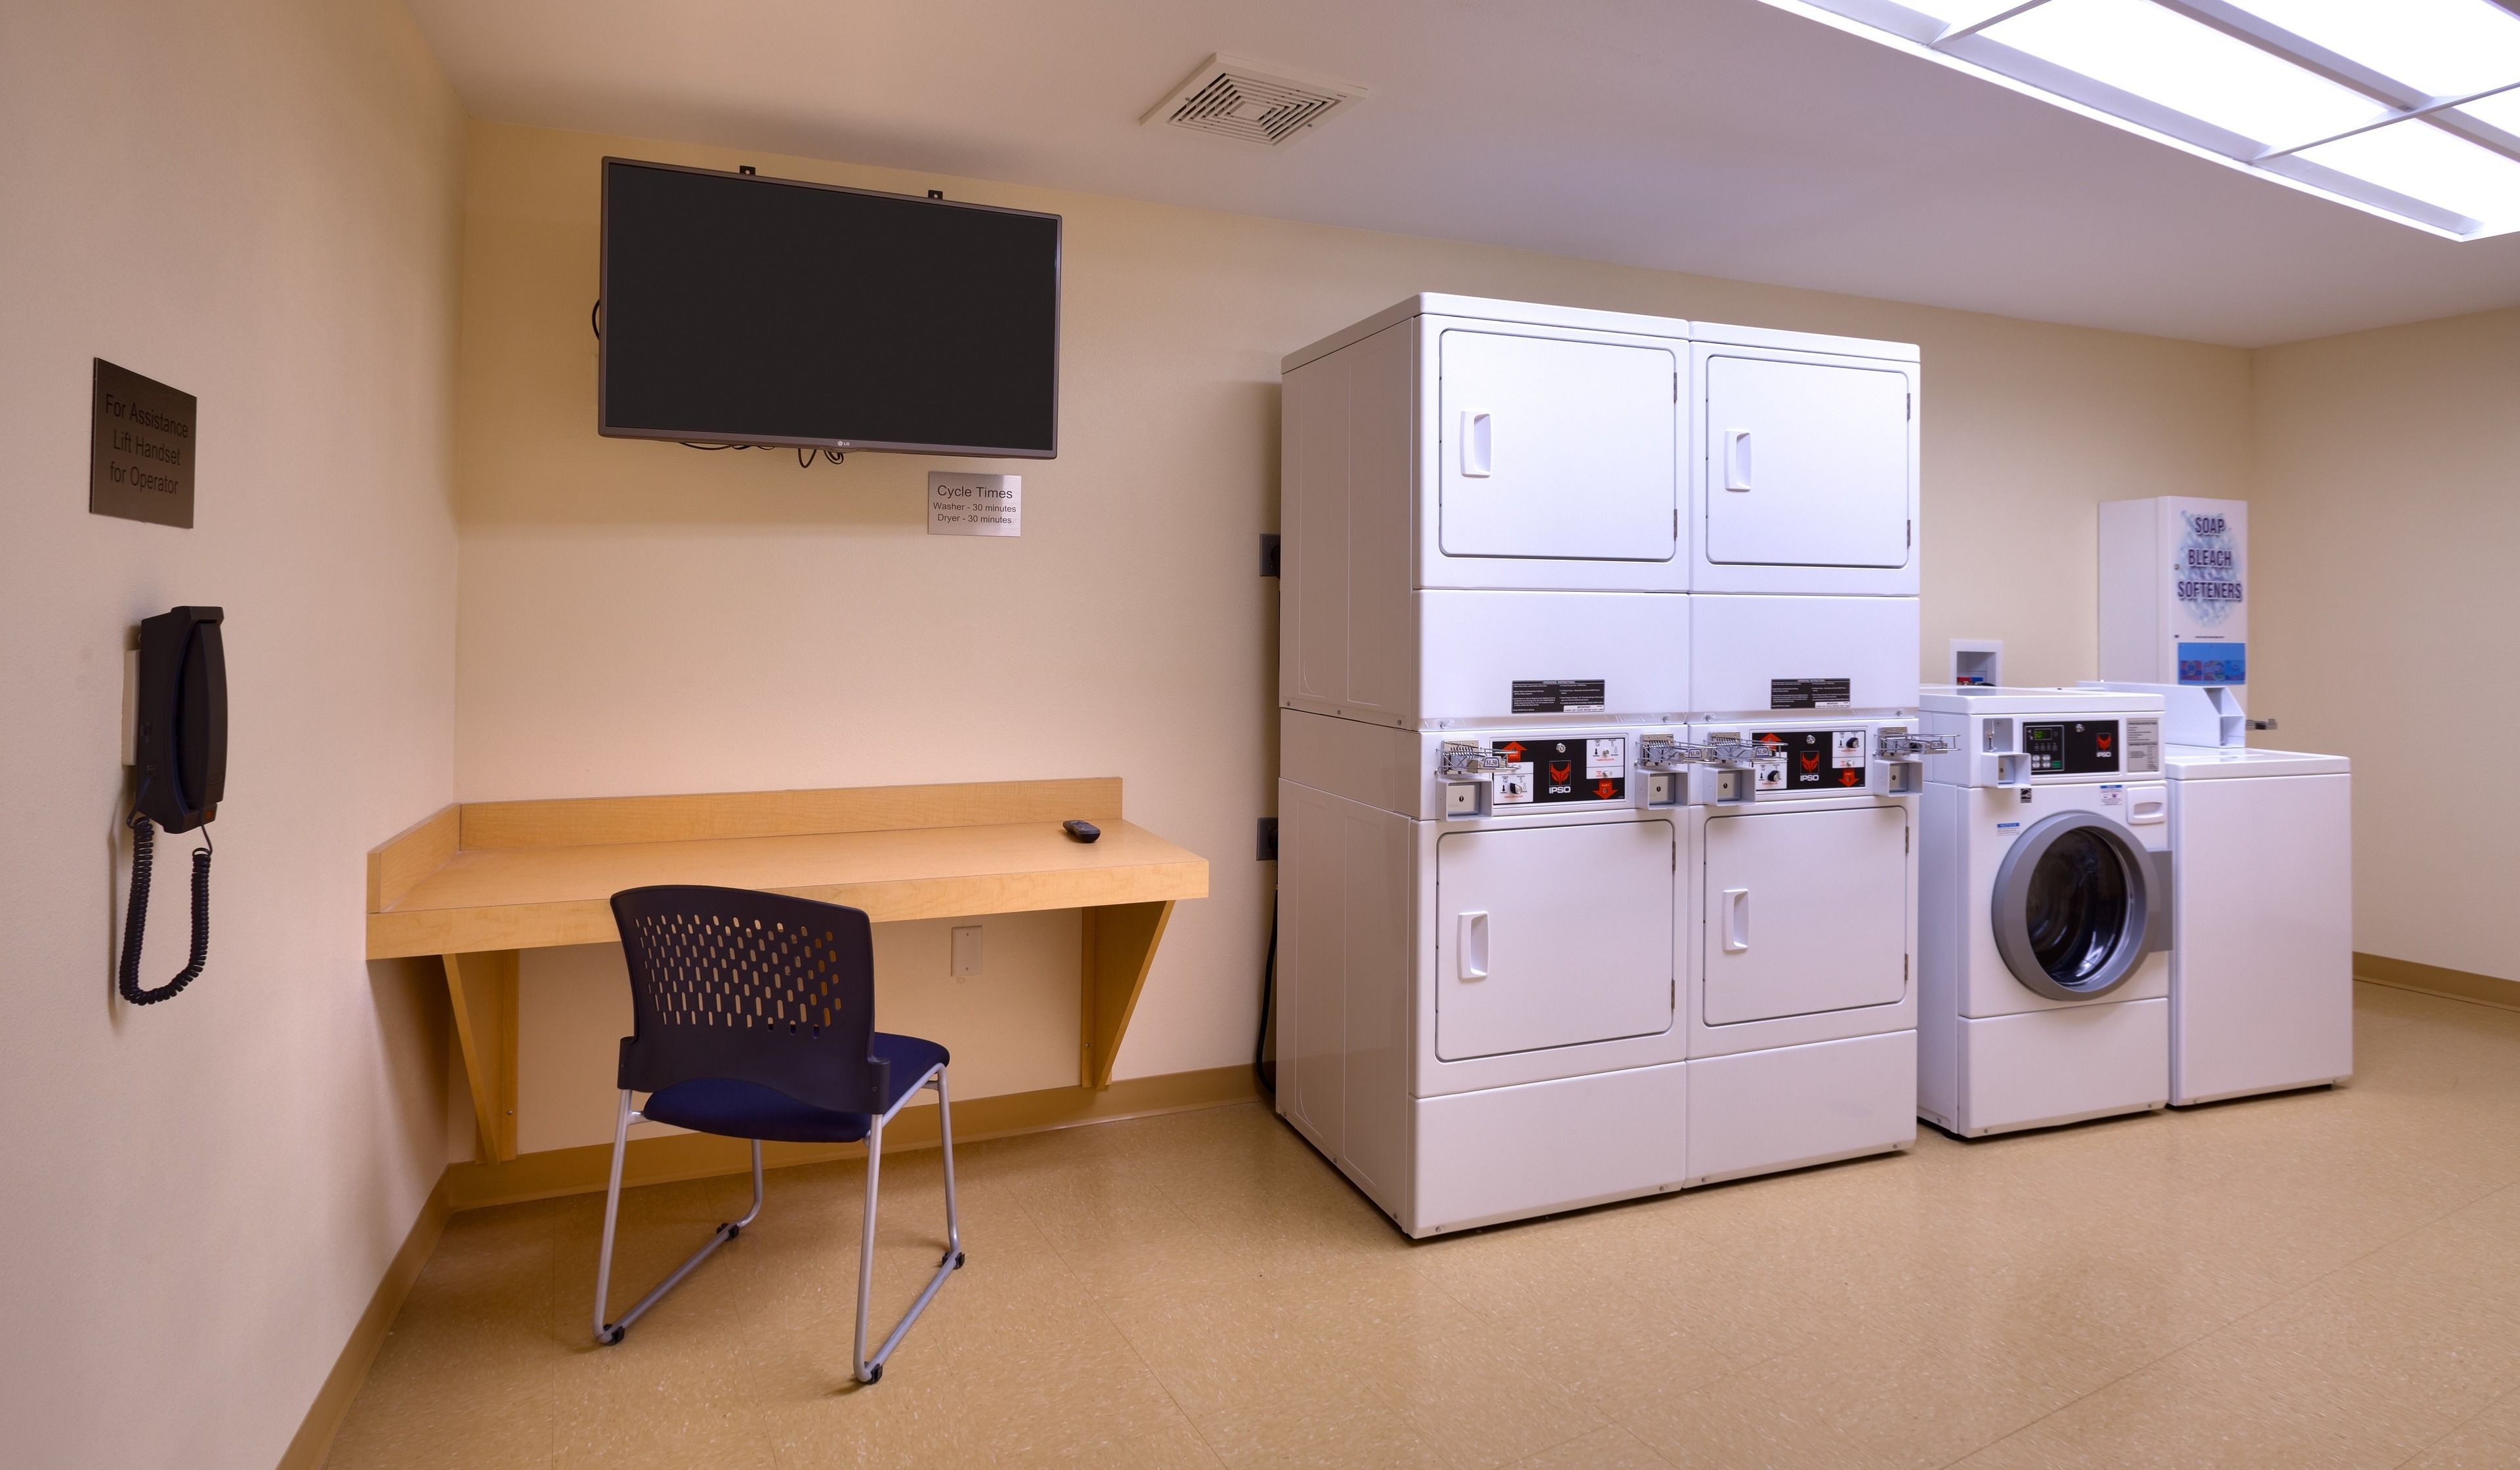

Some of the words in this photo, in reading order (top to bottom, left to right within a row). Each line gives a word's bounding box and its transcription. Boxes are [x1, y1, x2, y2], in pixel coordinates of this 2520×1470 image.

[106, 394, 126, 419] For
[129, 402, 188, 438] Assistance
[114, 429, 132, 453] Lift
[136, 435, 180, 466] Handset
[110, 461, 127, 483] for
[130, 466, 178, 494] Operator
[937, 485, 972, 499] Cycle
[976, 486, 1013, 499] Times
[937, 514, 960, 523] Dryer
[2195, 516, 2225, 534] SOAP
[2188, 549, 2232, 566] BLEACH
[2177, 581, 2242, 599] SOFTENERS
